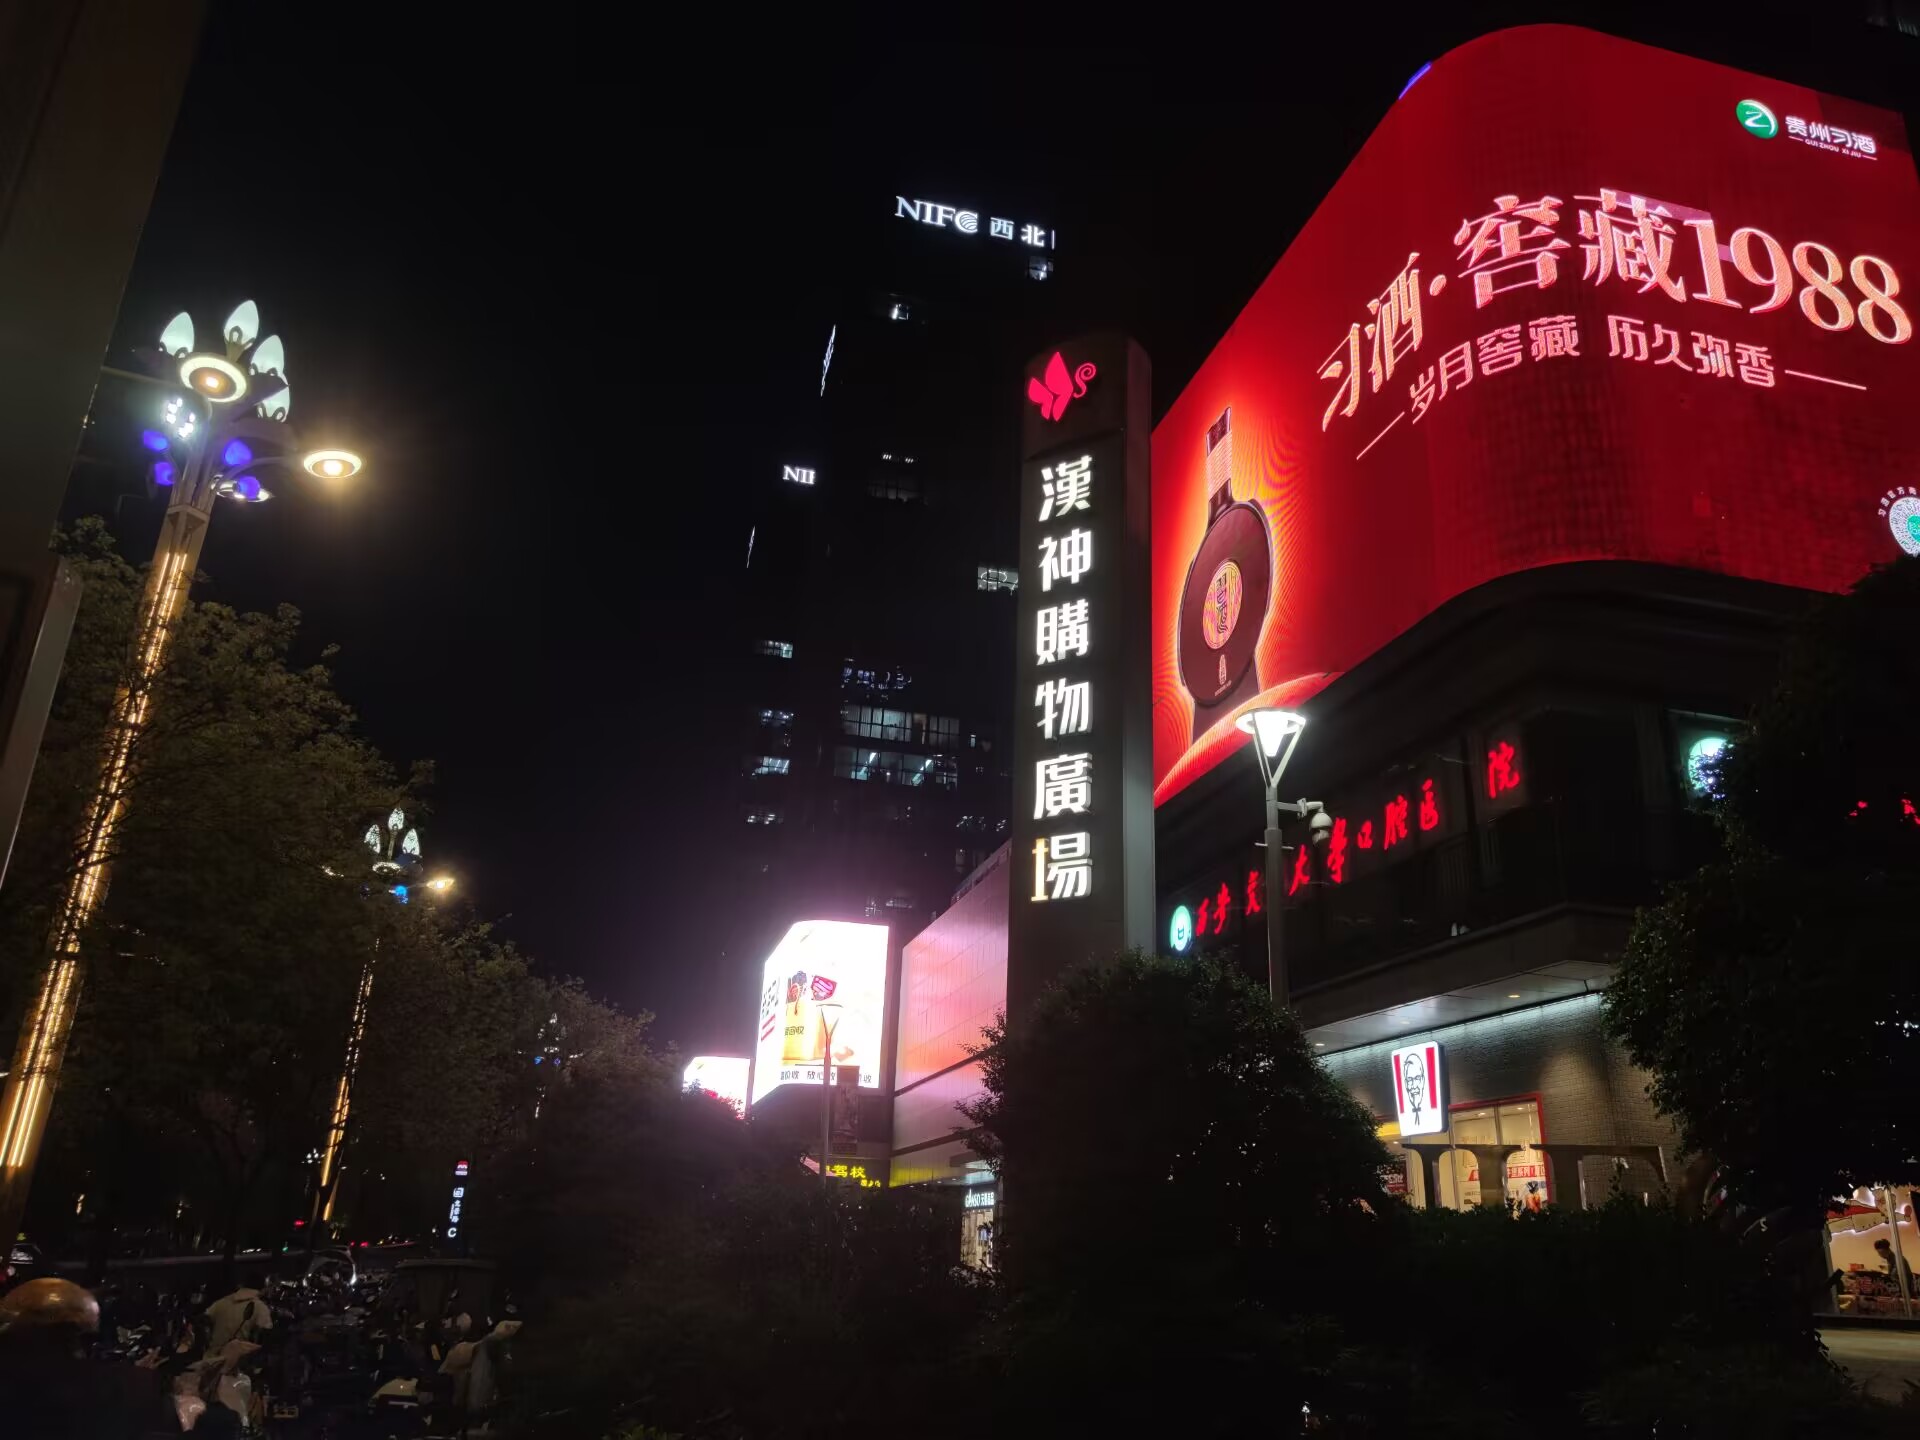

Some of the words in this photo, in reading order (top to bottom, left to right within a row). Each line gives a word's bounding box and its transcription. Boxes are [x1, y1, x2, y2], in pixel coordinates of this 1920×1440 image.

[1785, 116, 1876, 154] 贵州习酒
[1410, 314, 1581, 425] 岁月窖藏
[1607, 315, 1776, 388] 历久弥香
[1031, 454, 1094, 903] 漢神購物廣場
[826, 1164, 867, 1179] 驾校
[447, 1227, 457, 1238] C
